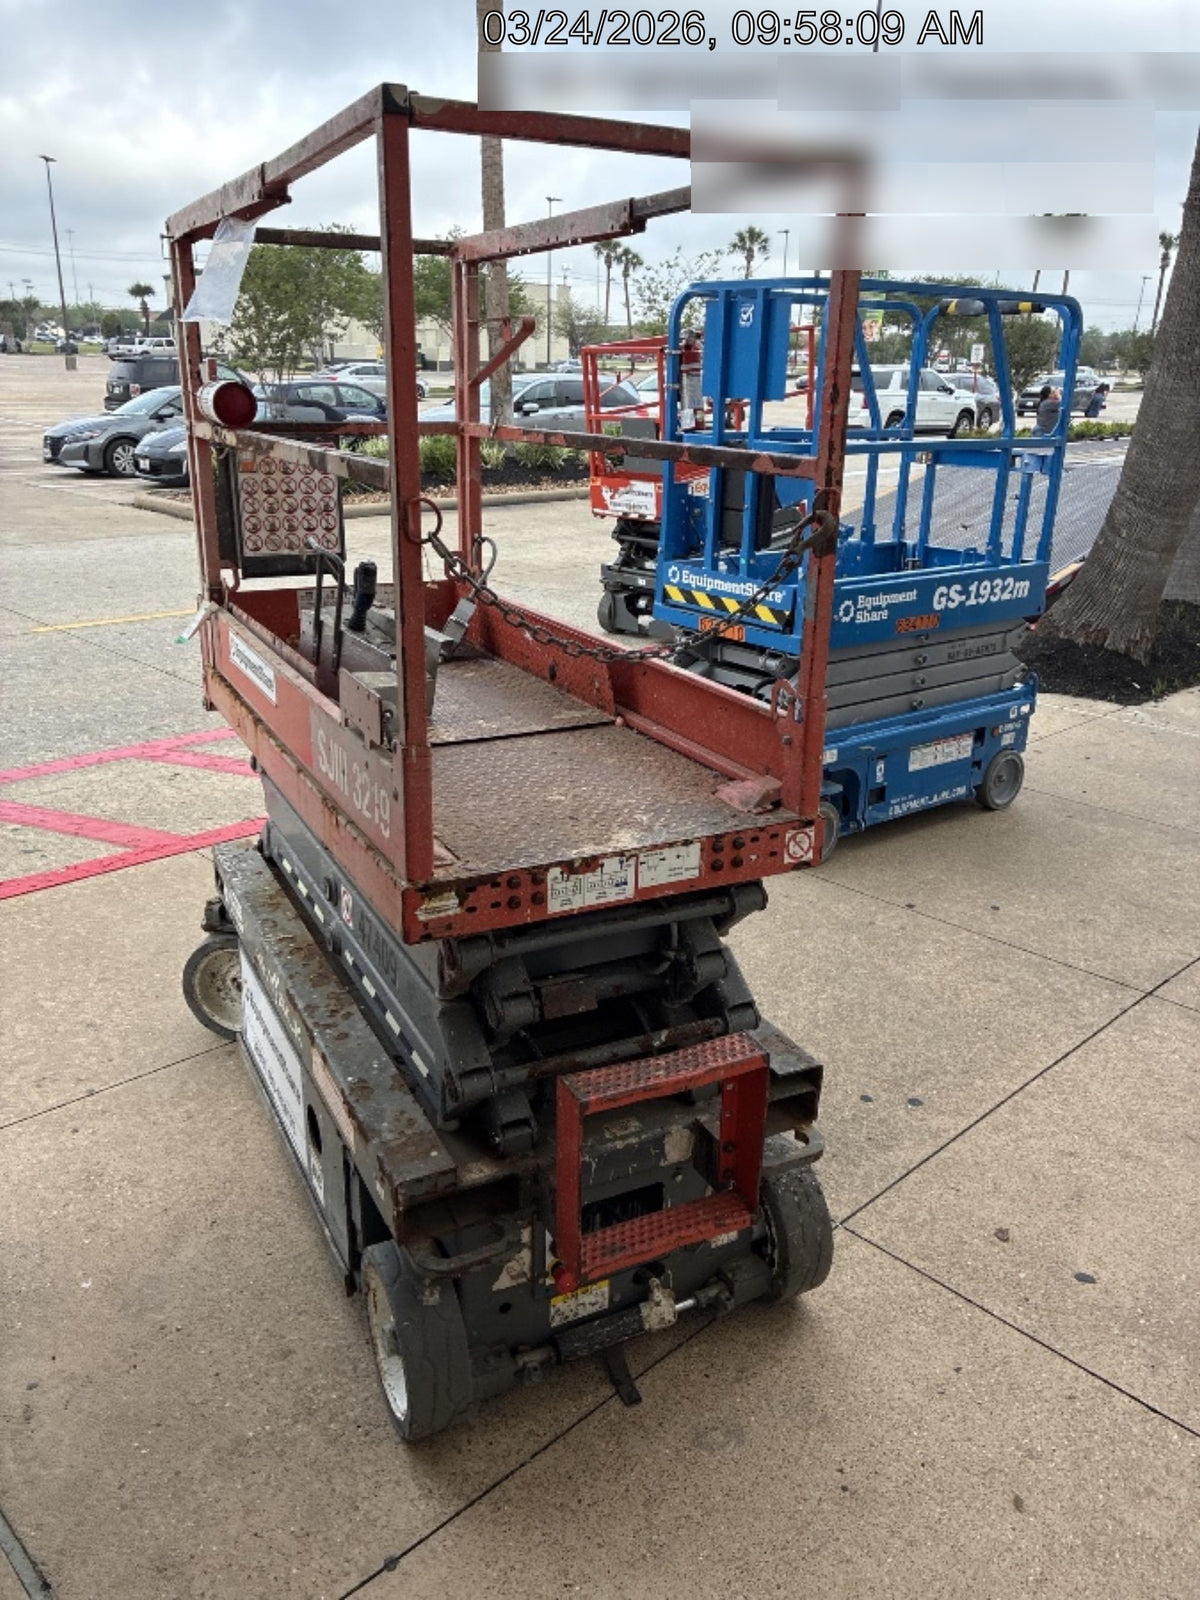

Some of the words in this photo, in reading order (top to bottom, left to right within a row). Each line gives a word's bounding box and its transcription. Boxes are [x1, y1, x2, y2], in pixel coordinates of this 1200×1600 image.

[682, 569, 784, 604] EquipmentShre
[856, 588, 918, 609] Equipment
[932, 576, 1031, 611] GS-1932m
[854, 608, 889, 624] Share
